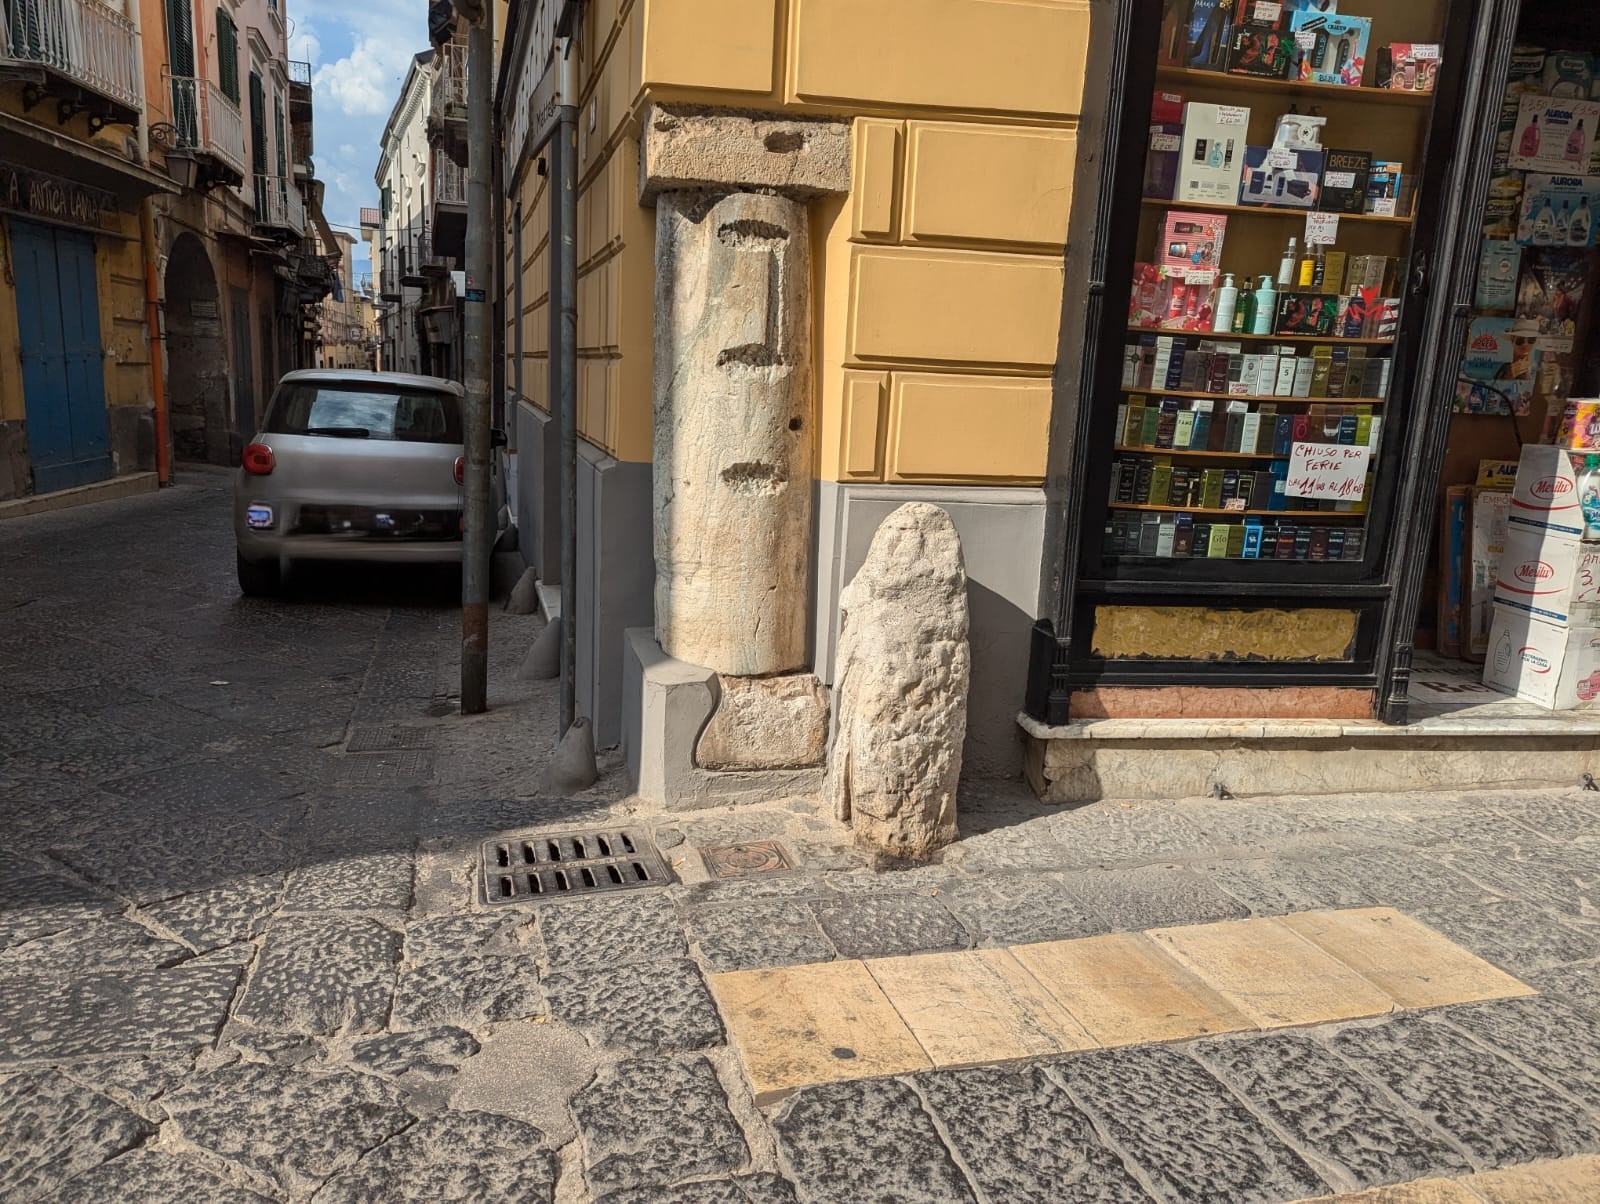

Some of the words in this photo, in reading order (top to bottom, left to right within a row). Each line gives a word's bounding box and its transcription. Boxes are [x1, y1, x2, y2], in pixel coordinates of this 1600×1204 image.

[1329, 154, 1369, 169] BREEZE
[1549, 175, 1583, 187] AURORA
[1294, 444, 1338, 458] CHIUSO
[1343, 449, 1362, 459] PER
[1305, 459, 1343, 472] FERIE
[1288, 478, 1301, 487] DAL
[1329, 480, 1338, 491] AL
